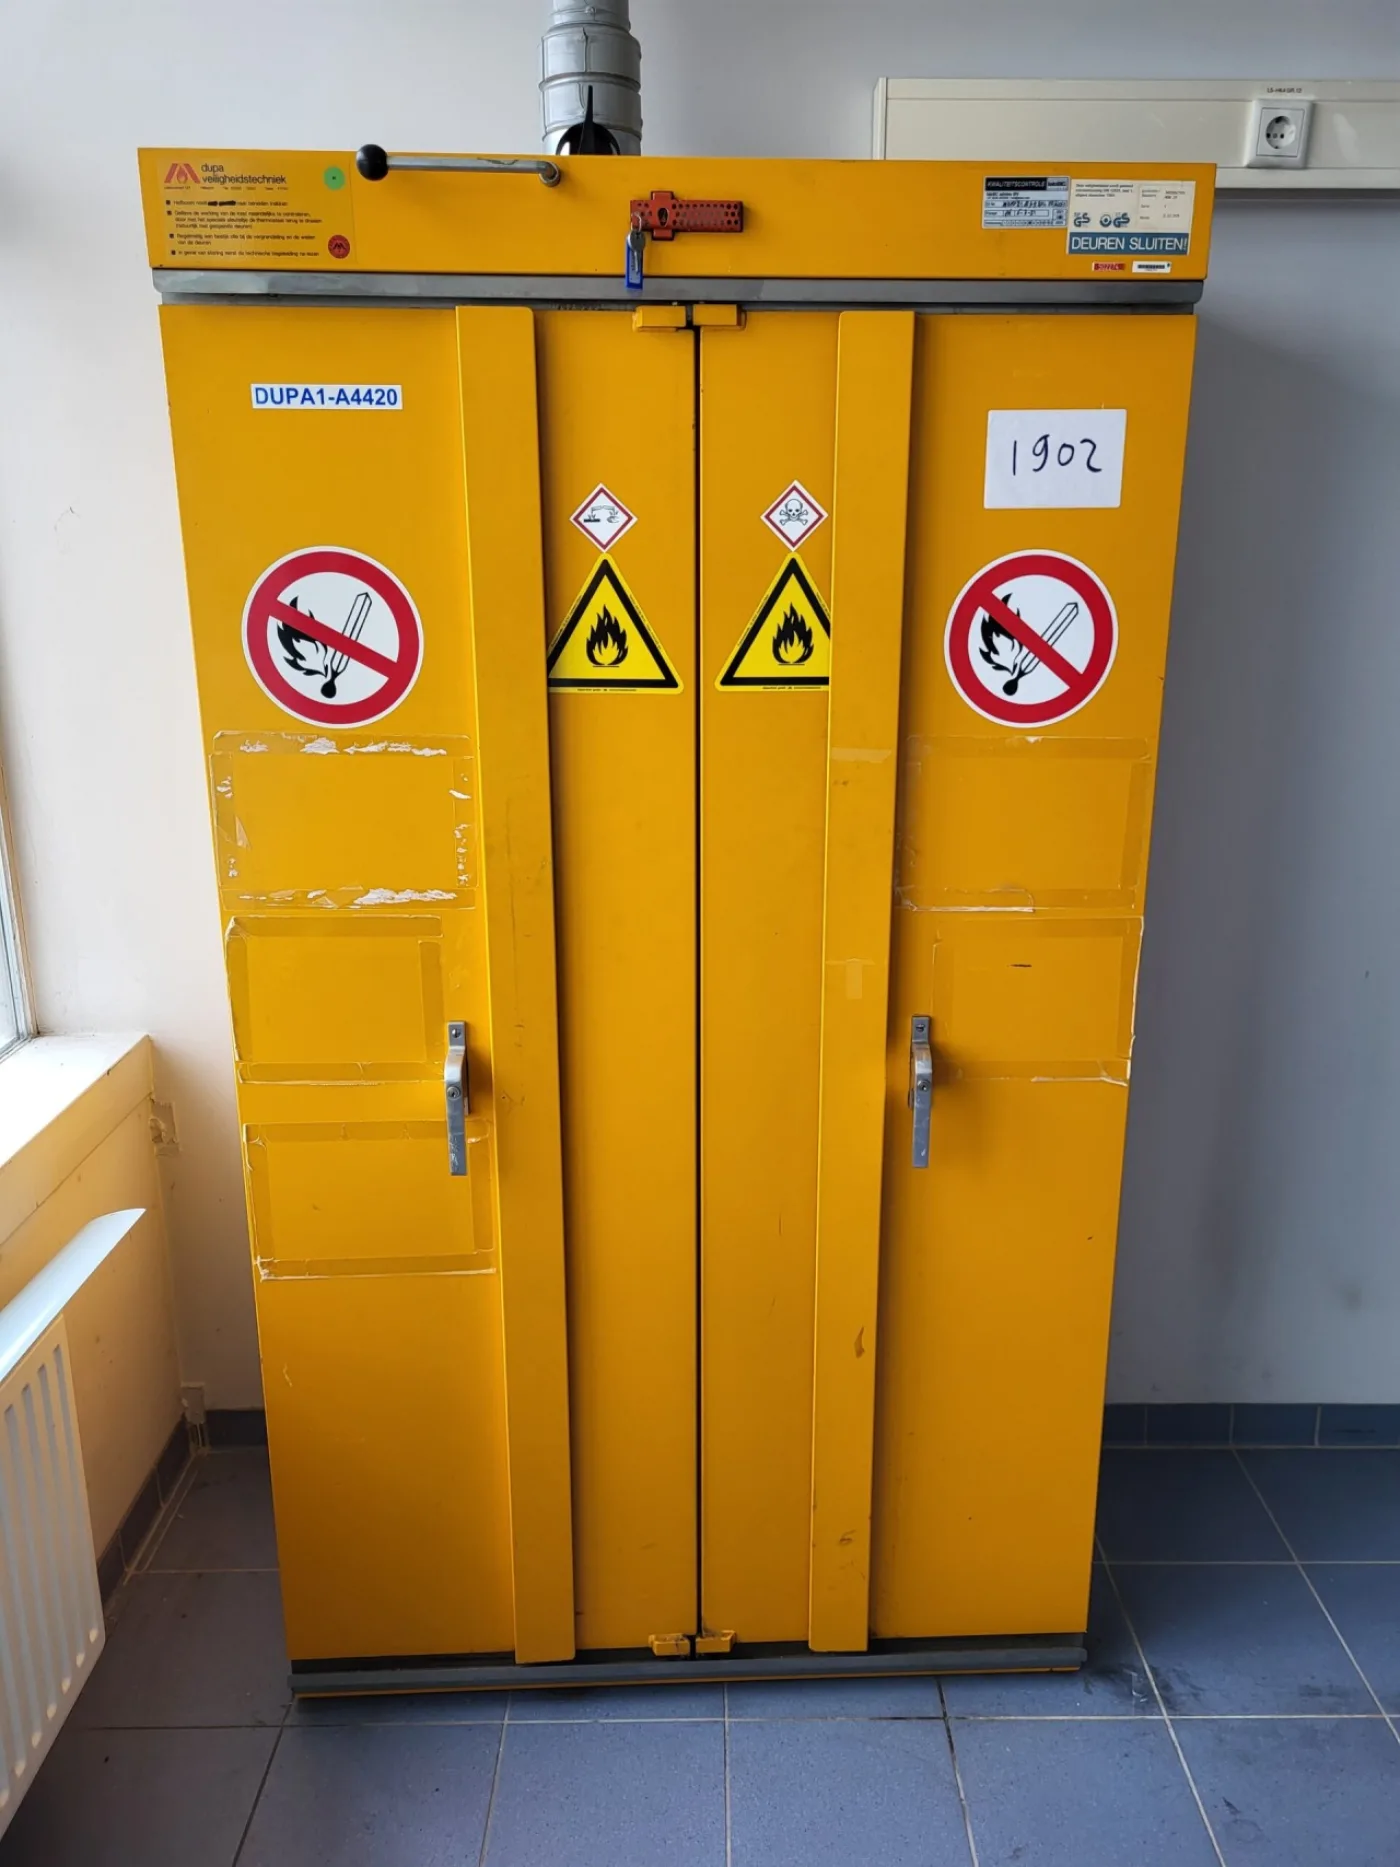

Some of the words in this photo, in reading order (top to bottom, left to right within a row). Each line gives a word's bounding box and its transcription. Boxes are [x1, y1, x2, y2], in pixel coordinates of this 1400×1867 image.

[201, 163, 224, 176] dupa
[202, 174, 286, 185] veiligheidstechniek
[1071, 236, 1124, 250] DEUREN
[1129, 238, 1188, 251] SLUITEN!
[255, 387, 398, 406] DUPA1-A4420
[1012, 434, 1102, 476] 1902
